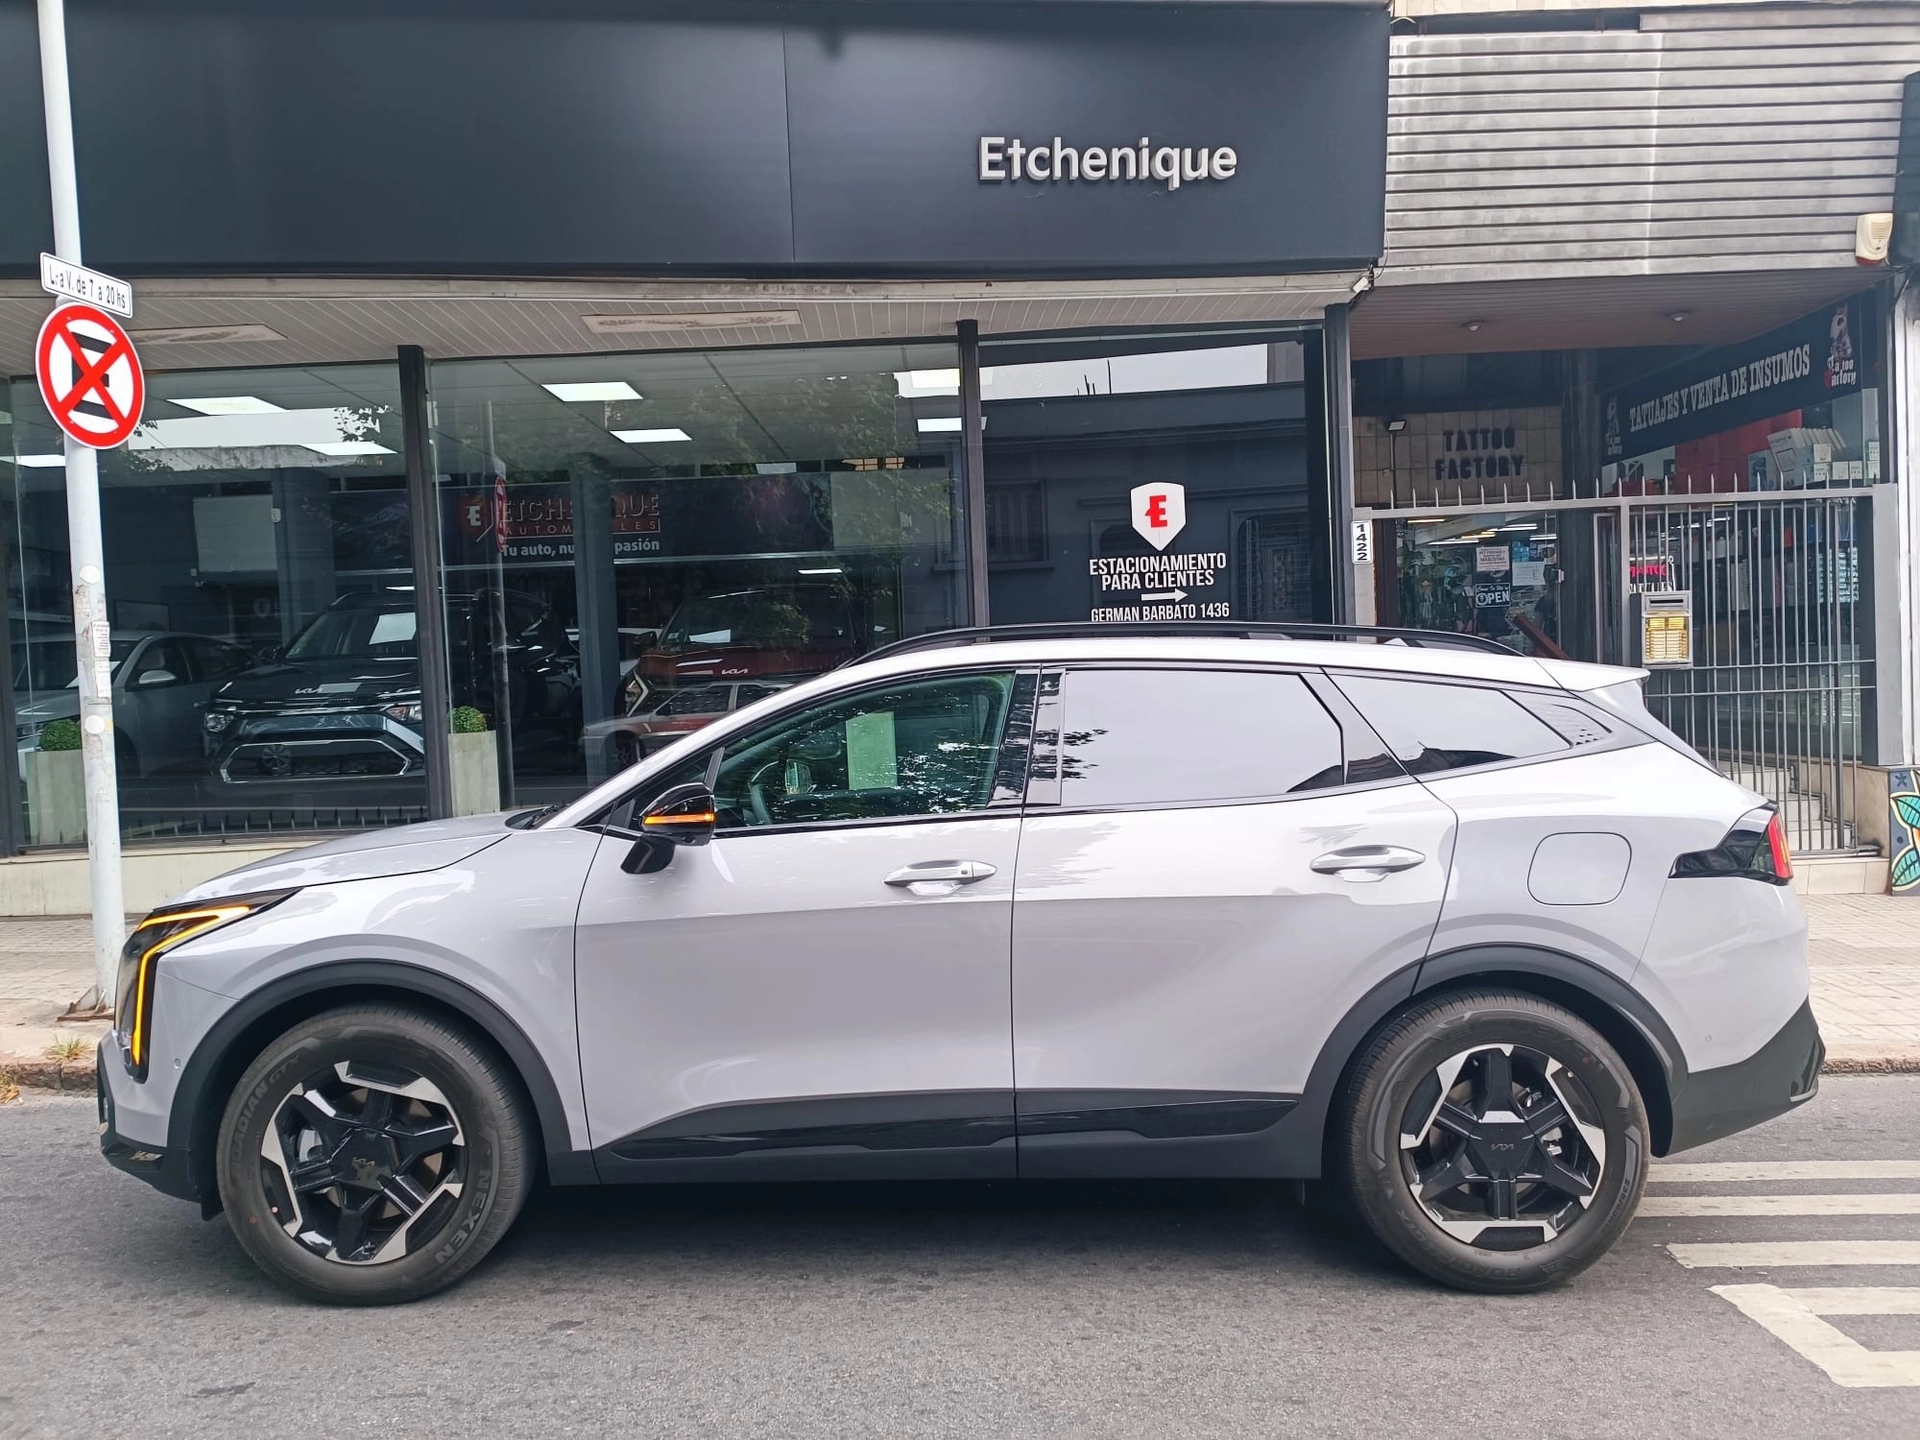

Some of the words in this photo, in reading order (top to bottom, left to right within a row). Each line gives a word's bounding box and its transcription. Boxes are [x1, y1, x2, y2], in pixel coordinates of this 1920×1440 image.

[979, 136, 1238, 191] Etchenique
[77, 274, 87, 295] de
[89, 279, 94, 298] 7
[98, 286, 103, 301] a
[1629, 386, 1679, 432] TATUAJES
[1680, 387, 1690, 416] Y
[1690, 373, 1729, 412] VENTA
[1731, 366, 1748, 398] DE
[1749, 343, 1810, 392] INSUMOS
[1443, 427, 1515, 452] TATTOO
[1435, 455, 1523, 480] FACTORY
[502, 494, 660, 523] ETCHQUE
[1144, 494, 1168, 528] E
[505, 520, 657, 536] AUTOMLES
[520, 543, 556, 557] auto,
[614, 538, 660, 555] pasión
[1356, 523, 1368, 561] 1422
[1089, 552, 1227, 575] ESTACIONAMIENTO
[1101, 573, 1141, 591] PARA
[1144, 569, 1214, 588] CLIENTES
[1475, 590, 1510, 606] OPEN
[1091, 606, 1139, 622] GERMAN
[1142, 604, 1196, 621] BARBATO
[1200, 602, 1230, 618] 1436
[434, 1169, 491, 1265] NEXEN
